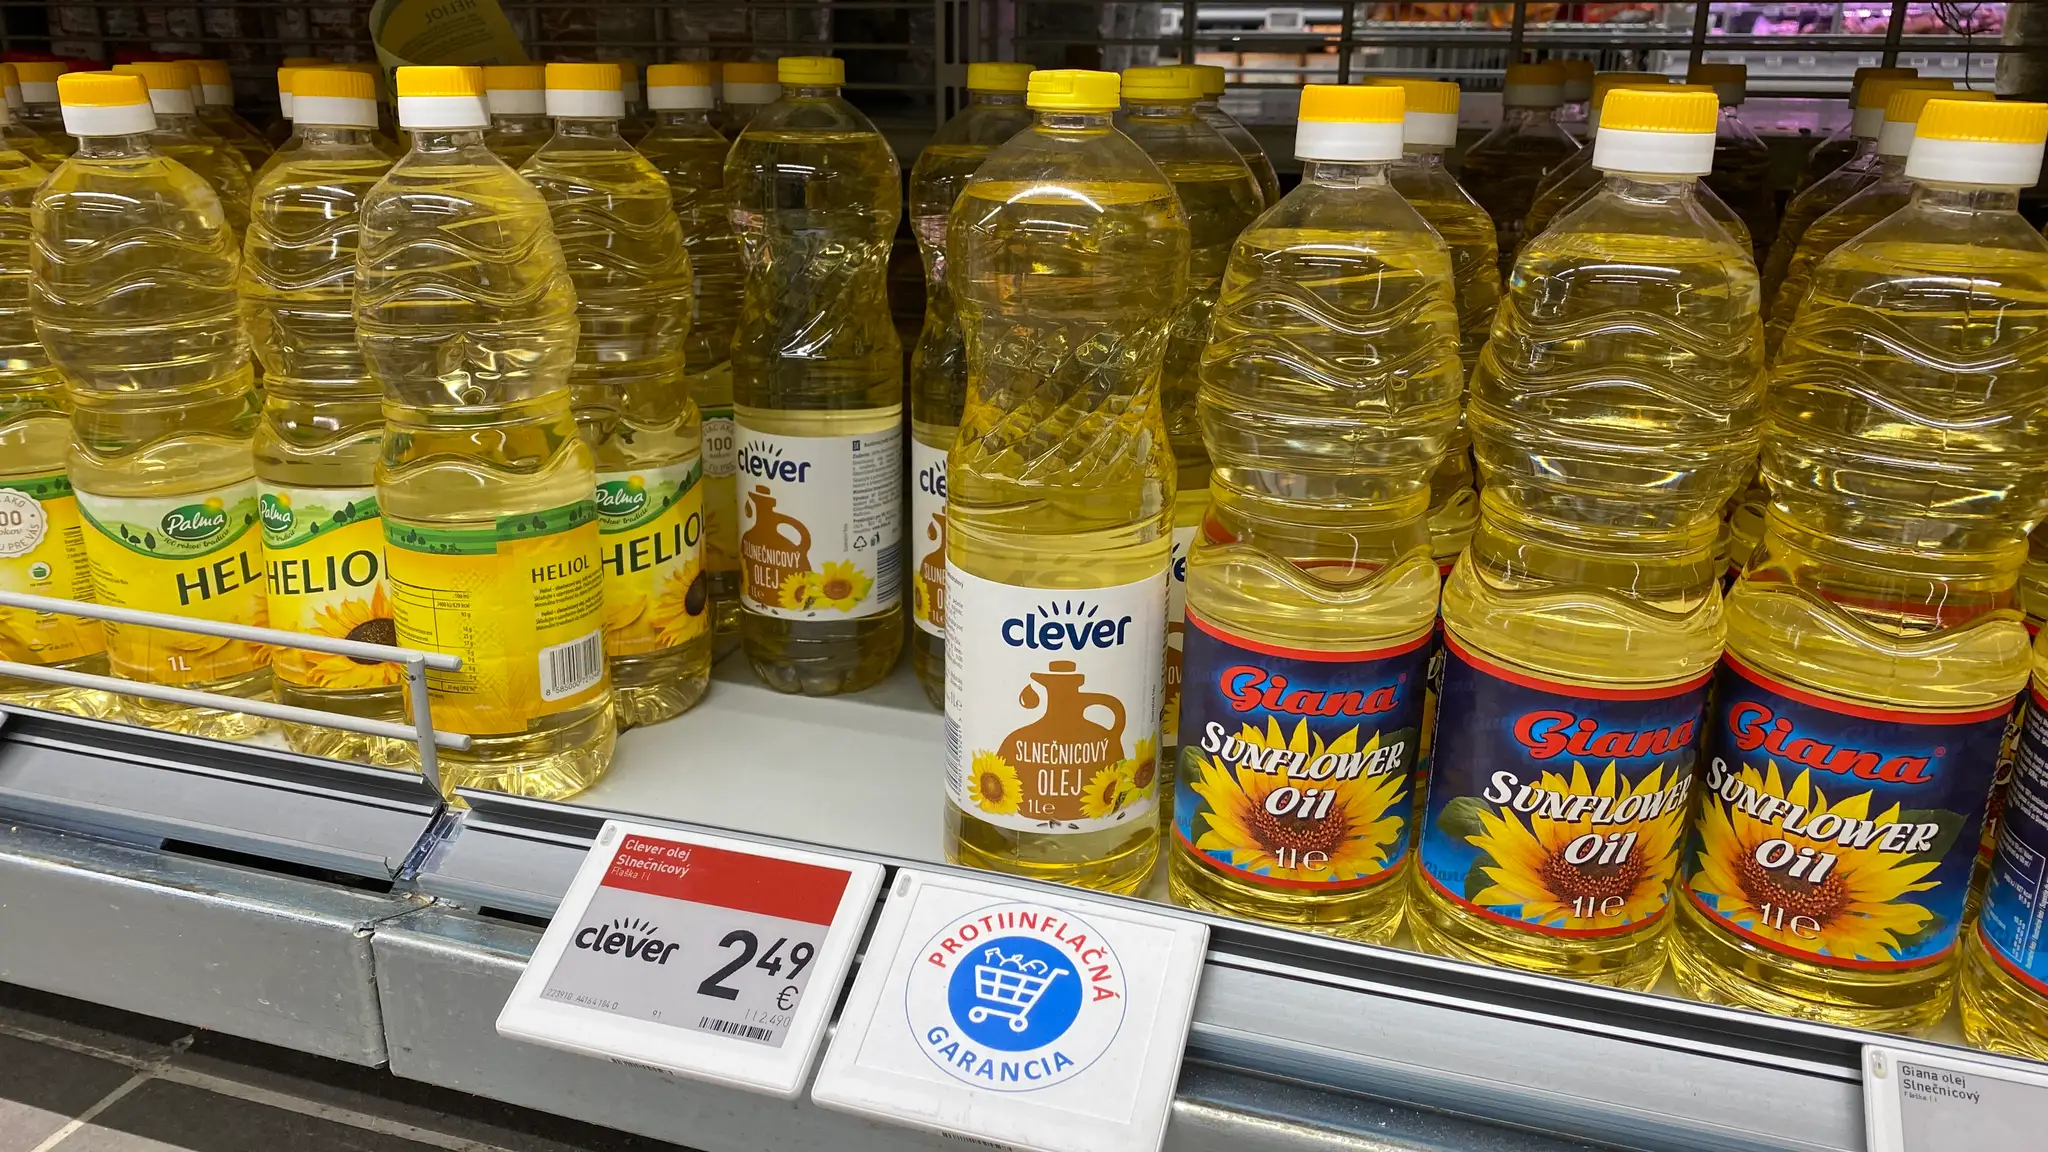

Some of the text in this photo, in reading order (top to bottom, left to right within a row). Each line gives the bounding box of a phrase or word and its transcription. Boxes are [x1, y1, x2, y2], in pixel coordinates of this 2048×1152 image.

[706, 436, 732, 451] 100
[736, 446, 811, 483] clever
[4, 495, 25, 508] AKO
[260, 499, 292, 522] Palma
[596, 488, 644, 506] Palma
[8, 539, 28, 552] PRE
[27, 523, 40, 538] VÁS
[167, 512, 225, 535] Palma
[600, 504, 705, 578] HELIOL
[176, 550, 262, 605] HEL
[532, 555, 590, 583] HELIOL
[754, 562, 779, 590] OLEJ
[1001, 613, 1131, 651] clever
[167, 655, 191, 672] 1L
[555, 680, 581, 694] 585000
[1220, 665, 1399, 717] Giana
[1513, 710, 1695, 759] Giana
[1728, 701, 1932, 784] Giana
[1016, 738, 1109, 764] SLNEČNICOVÝ
[1201, 721, 1405, 781] SUNFLOWER
[1037, 769, 1082, 797] OLEJ
[1265, 787, 1337, 820] Oil
[1483, 770, 1693, 826] SUNFLOWER
[1707, 757, 1939, 853] SUNFLOWER
[625, 839, 691, 862] Clever olej
[1563, 831, 1638, 866] Oil
[1755, 839, 1838, 884] Oil
[616, 854, 690, 878] Slnečnicový
[575, 922, 680, 965] clever
[928, 911, 1120, 1004] PROTIINFLAČNÁ
[776, 985, 799, 1011] €
[652, 1010, 662, 1019] 91
[927, 1025, 1074, 1082] GARANCIA
[1902, 1066, 1967, 1089] Giana olej
[1903, 1079, 1980, 1104] Slnečnicový
